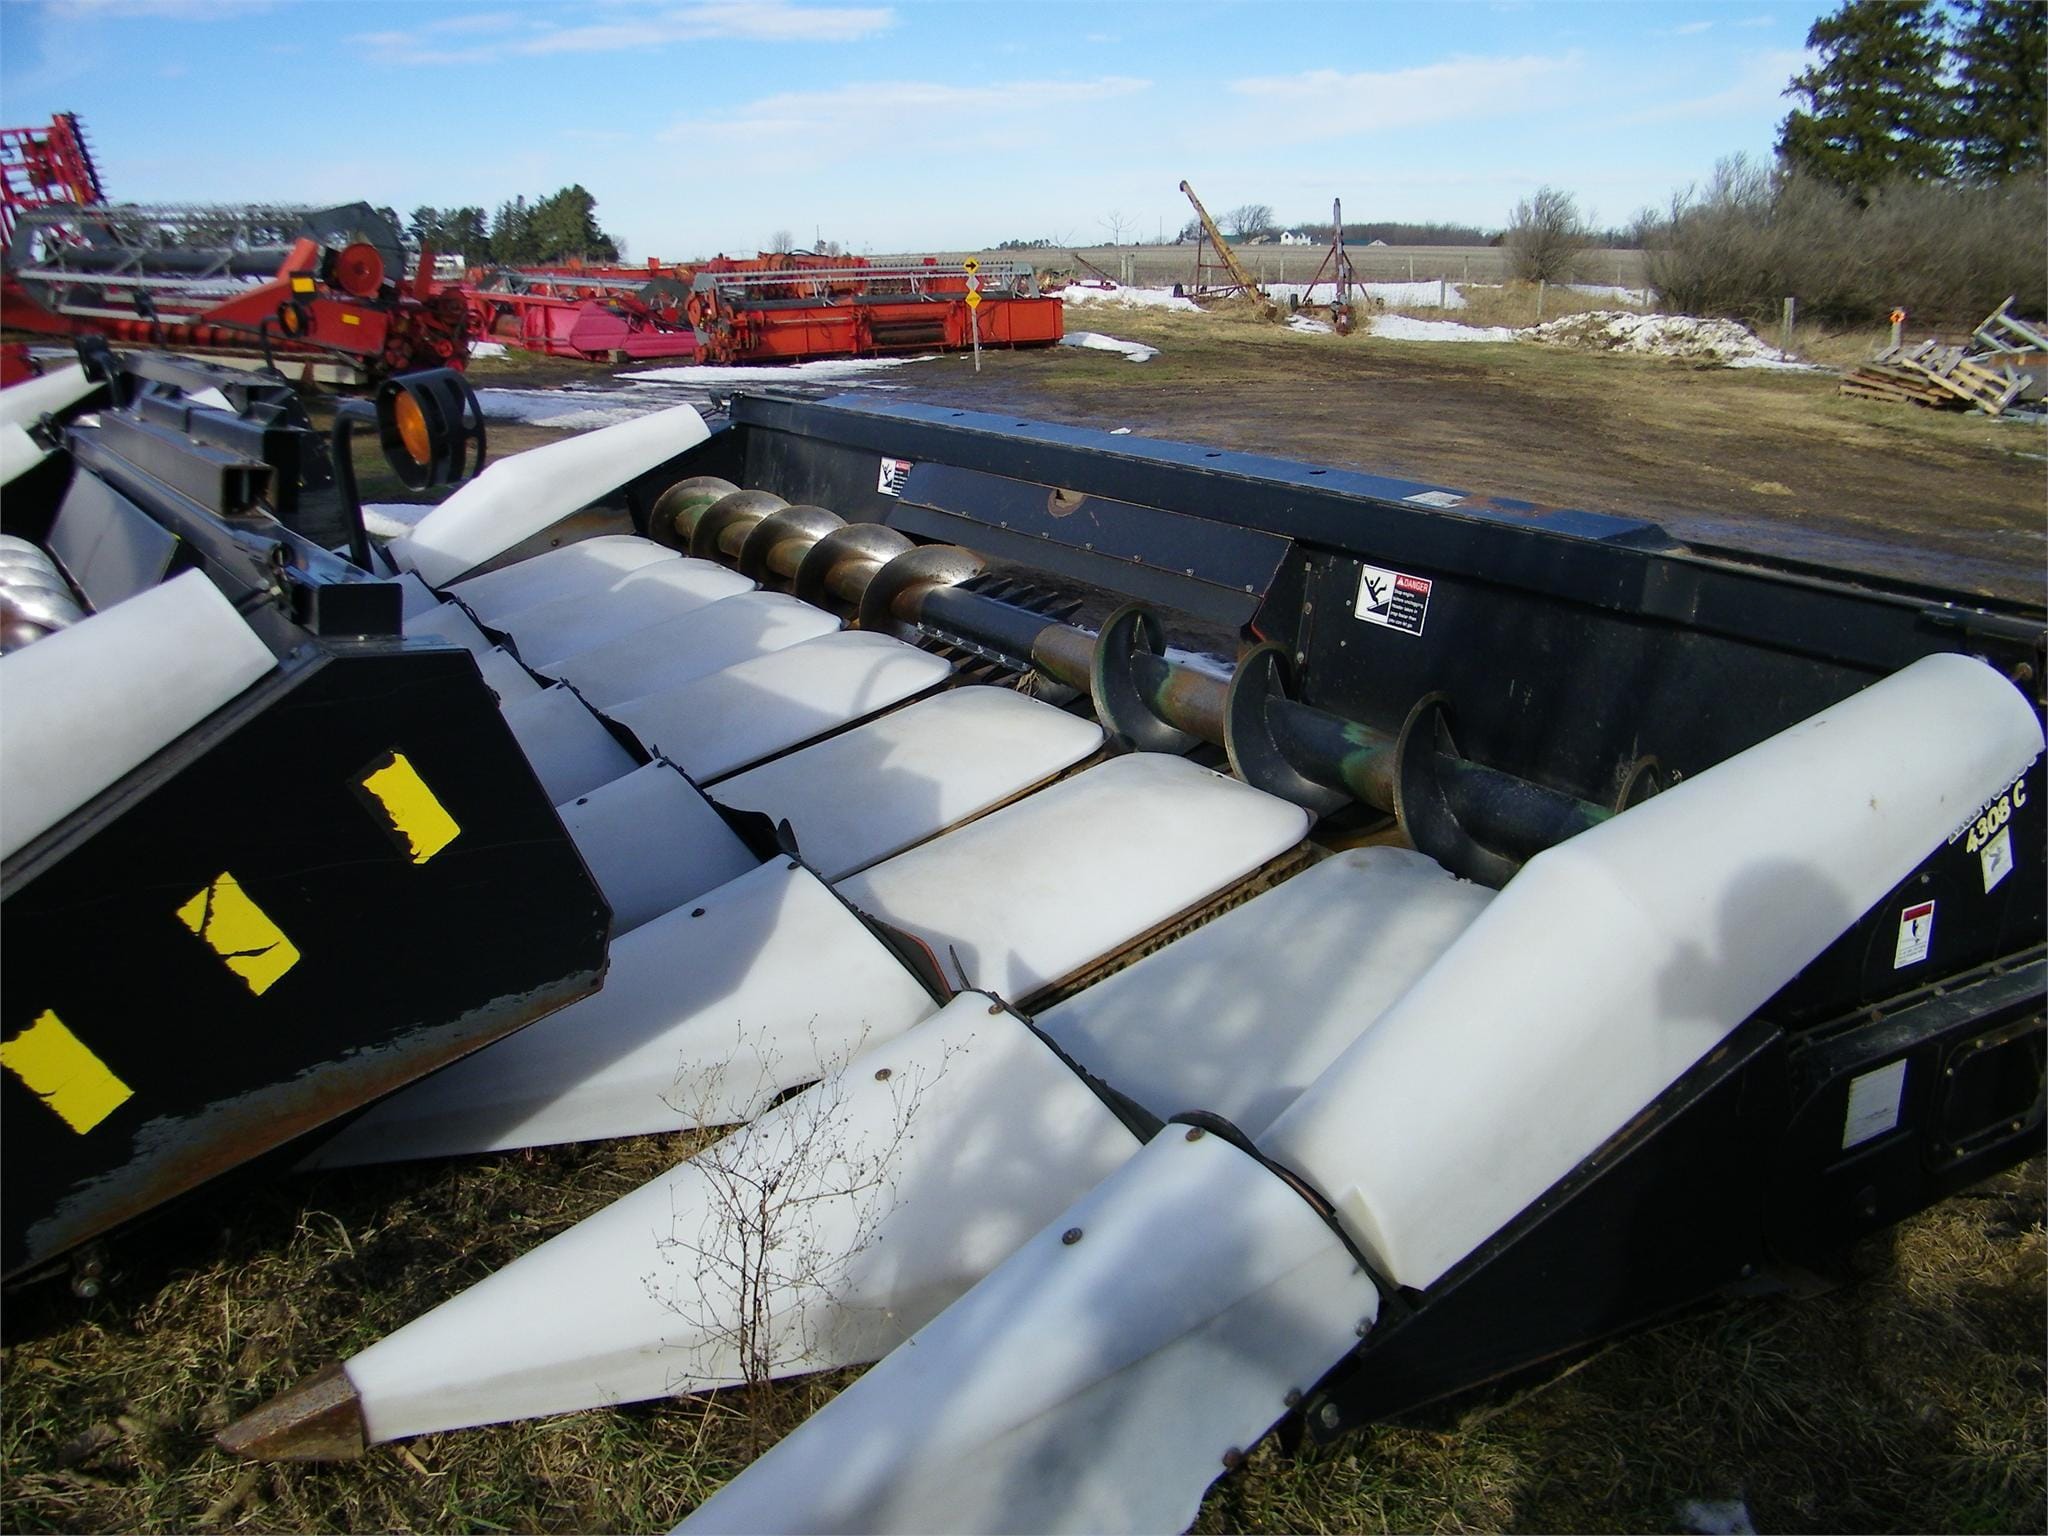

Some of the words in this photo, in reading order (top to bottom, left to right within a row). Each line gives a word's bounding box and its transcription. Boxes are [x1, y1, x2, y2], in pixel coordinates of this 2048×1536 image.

[1404, 579, 1428, 592] DANGER
[1966, 795, 2011, 853] 4308
[2012, 779, 2026, 808] C
